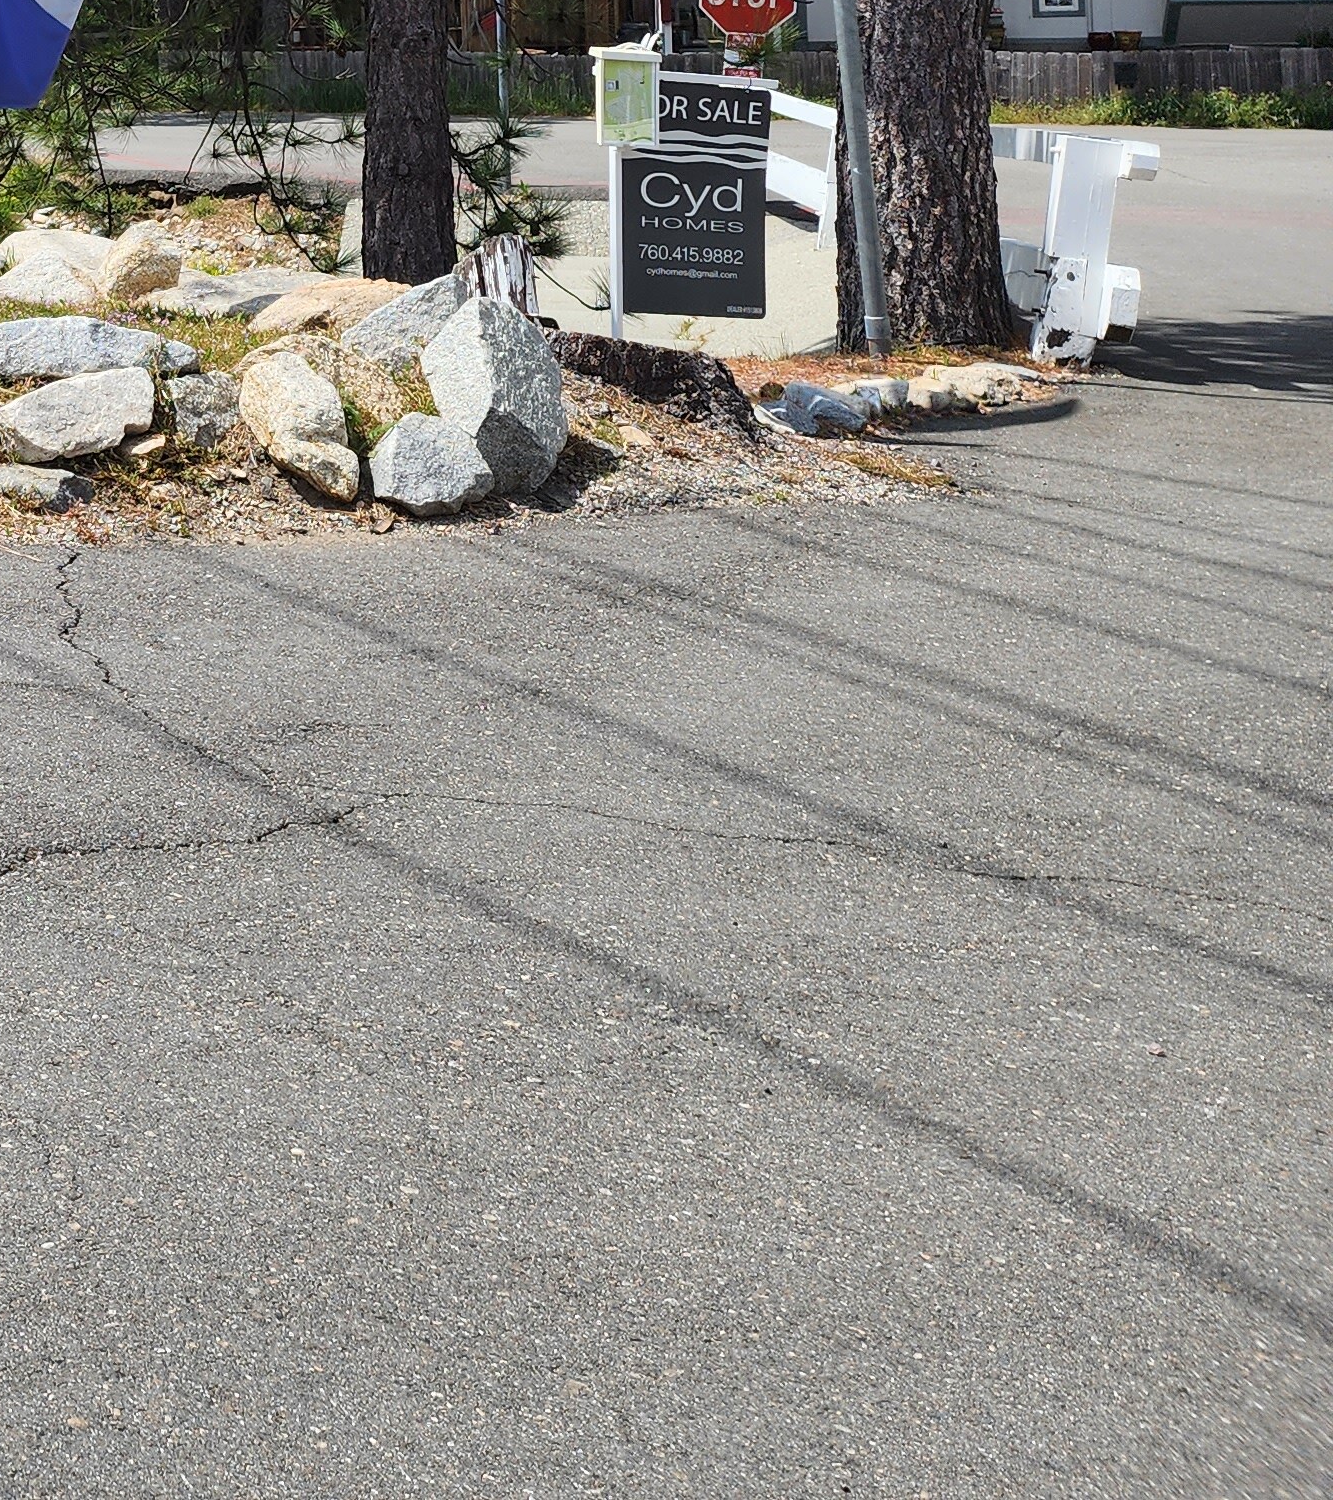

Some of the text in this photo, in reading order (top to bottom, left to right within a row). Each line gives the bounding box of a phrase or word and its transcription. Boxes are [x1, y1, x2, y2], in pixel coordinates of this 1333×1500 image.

[659, 94, 763, 126] OR SALE
[640, 172, 743, 217] Cyd
[641, 215, 744, 233] HOMES
[638, 243, 744, 265] 760.415.9882
[646, 267, 738, 279] cydhomes@gmail.com
